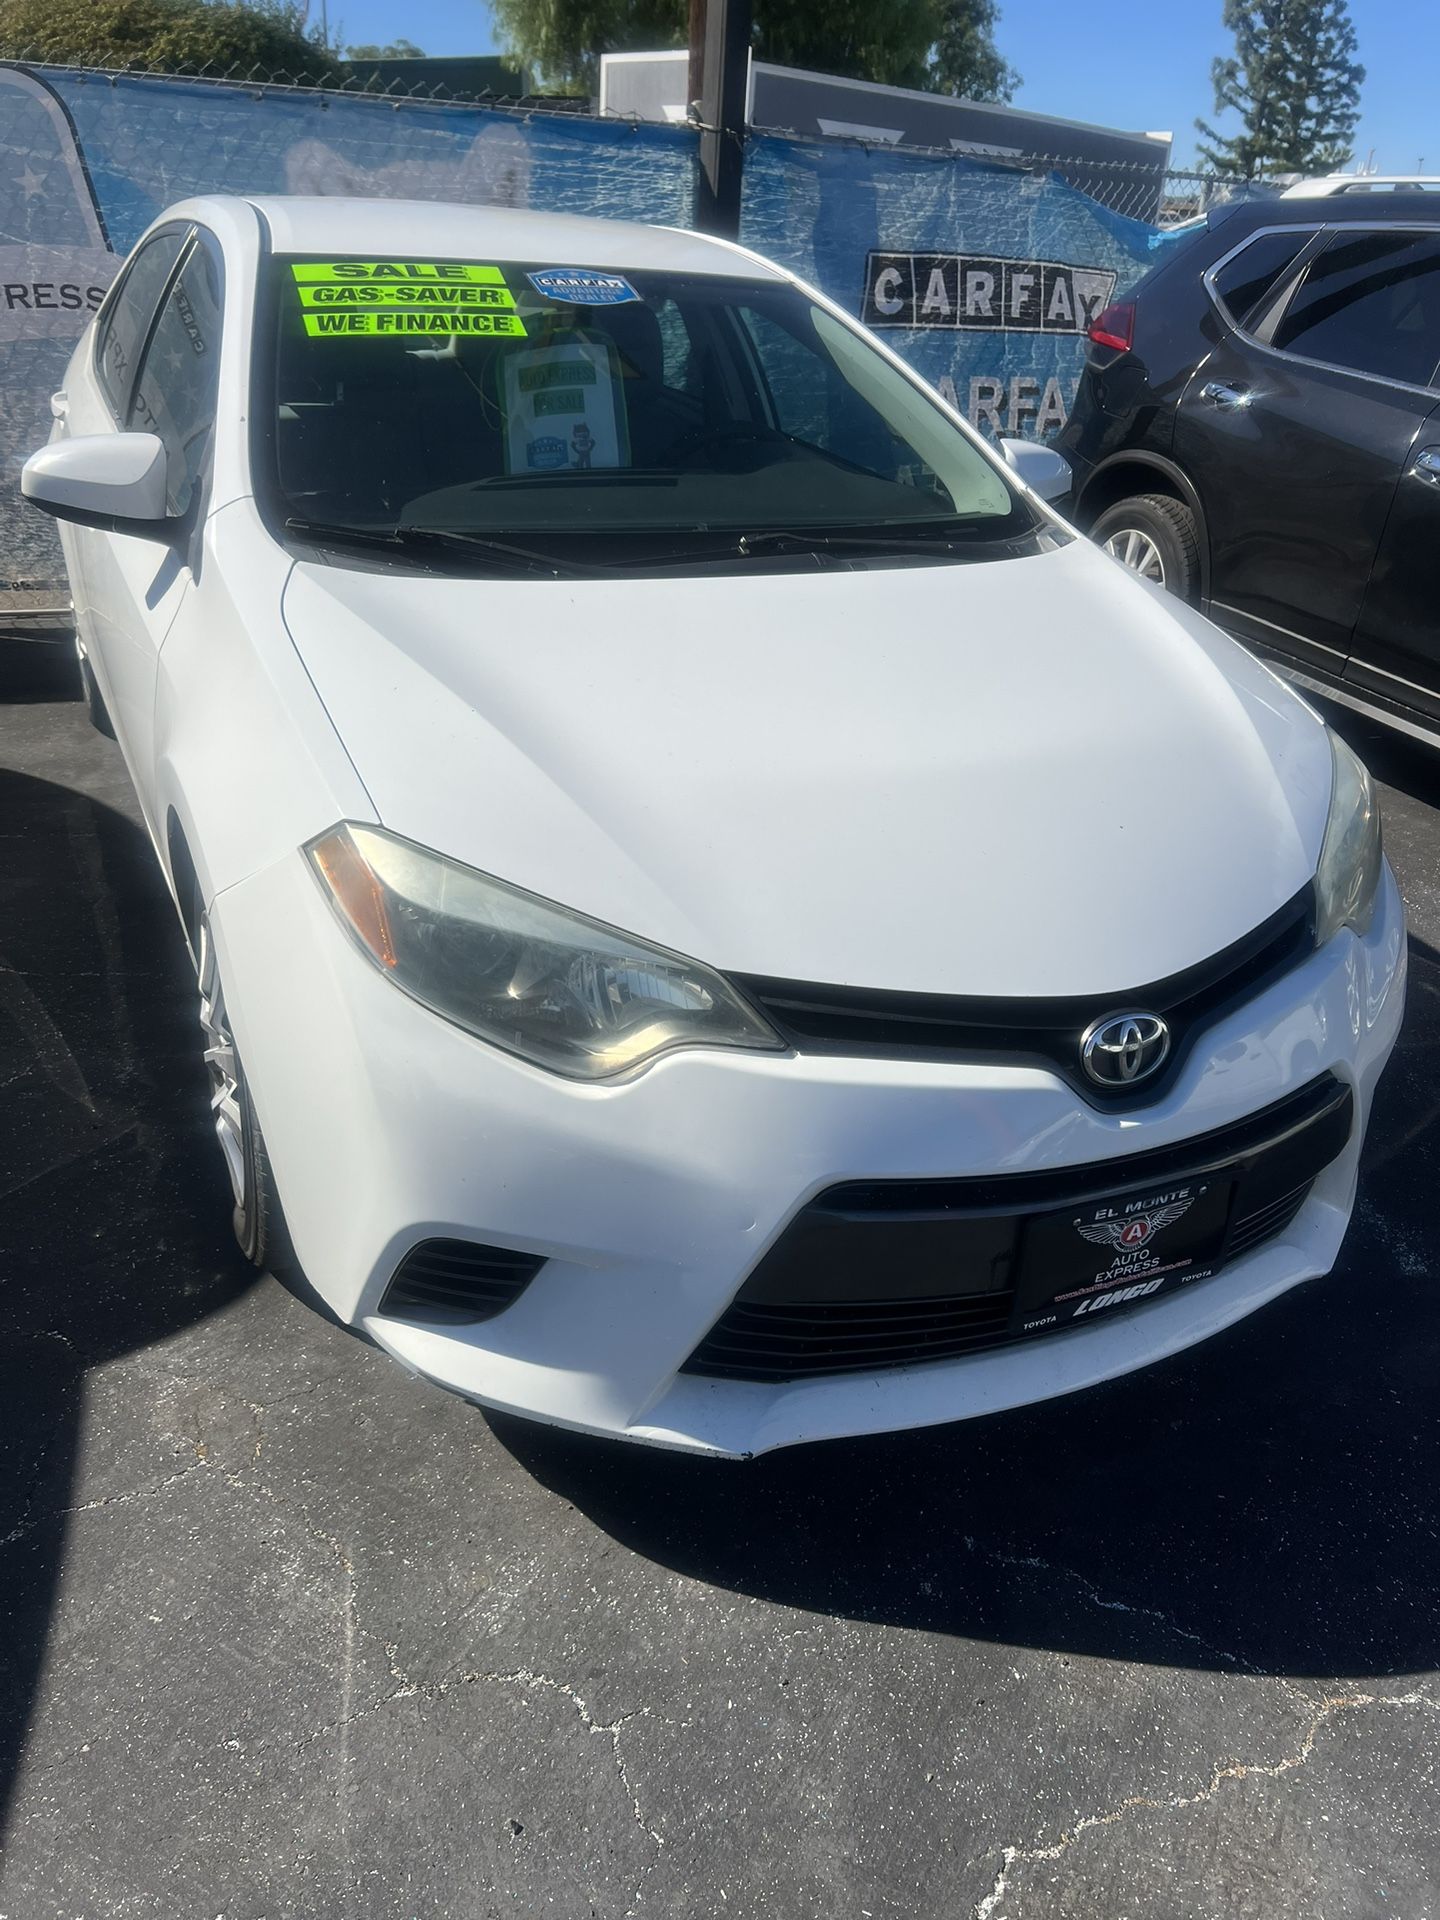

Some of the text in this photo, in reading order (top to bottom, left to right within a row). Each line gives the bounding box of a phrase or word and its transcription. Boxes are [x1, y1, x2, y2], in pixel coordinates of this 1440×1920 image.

[332, 264, 471, 280] SALE
[539, 278, 625, 288] CARFAX
[312, 287, 504, 305] GAS-SAVER
[569, 294, 618, 302] DEALER
[316, 314, 515, 333] WE FINANCE
[937, 375, 1081, 438] ARFA
[1094, 1187, 1190, 1221] EL MONTE
[1126, 1224, 1143, 1241] A
[1111, 1249, 1150, 1268] AUTO
[1095, 1257, 1160, 1283] EXPRESS
[1181, 1270, 1212, 1283] TOYOTA
[1073, 1277, 1165, 1317] LONGO
[1023, 1315, 1057, 1330] TOYOTA
